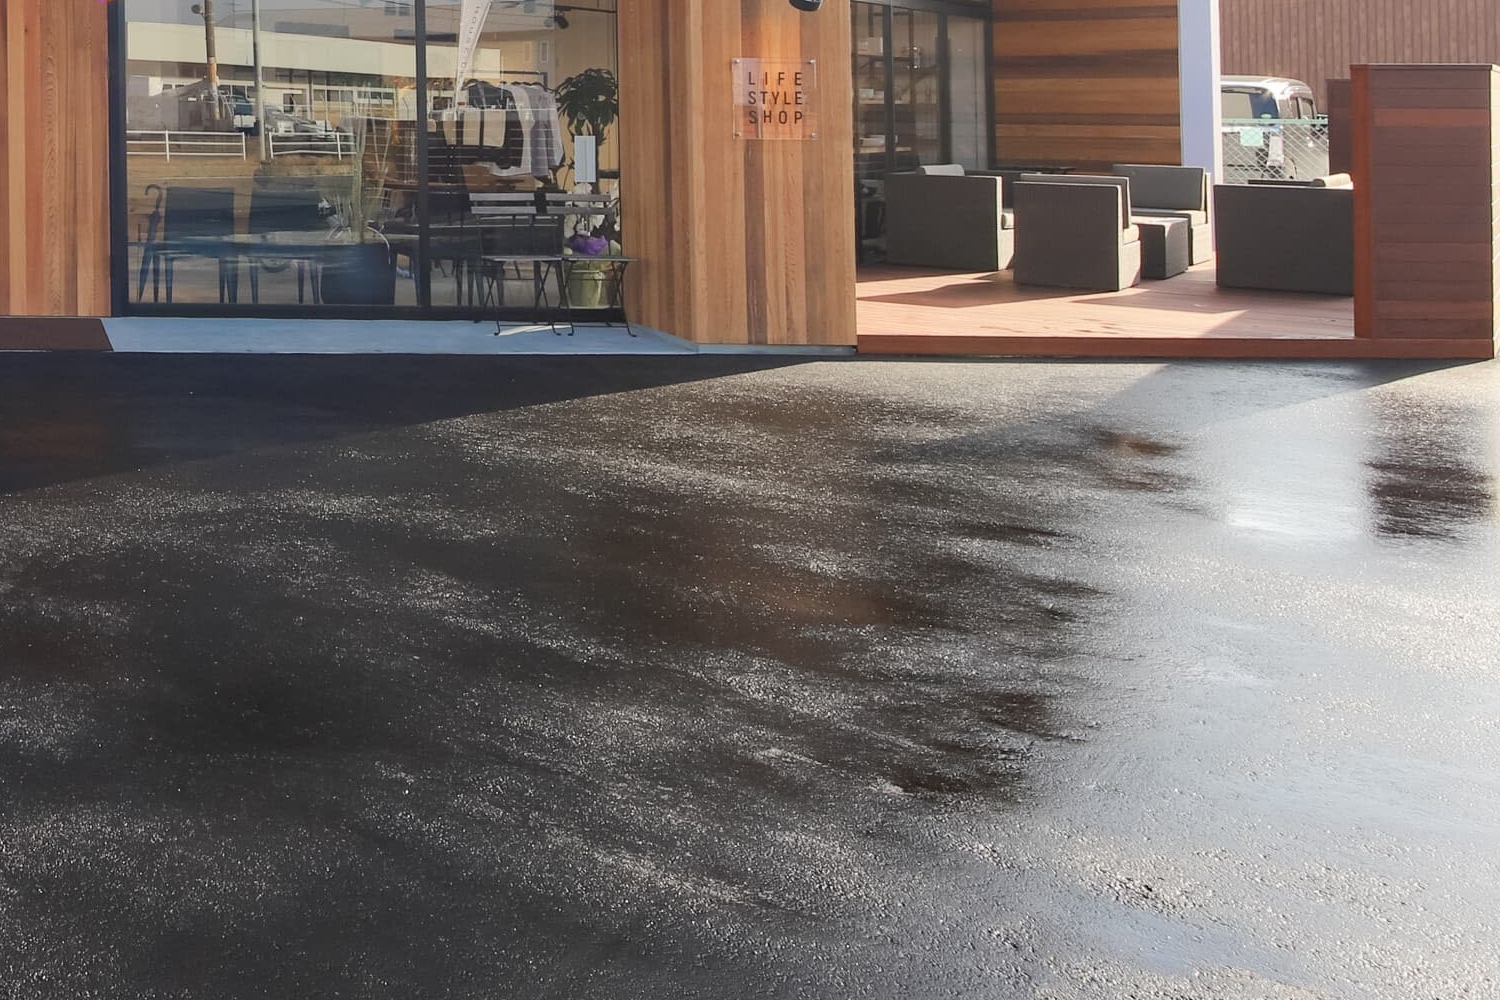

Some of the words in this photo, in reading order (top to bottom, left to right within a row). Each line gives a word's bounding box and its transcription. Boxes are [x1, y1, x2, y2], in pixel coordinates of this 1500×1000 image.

[748, 71, 803, 86] LIFE
[748, 90, 803, 105] STYLE
[748, 110, 803, 125] SHOP
